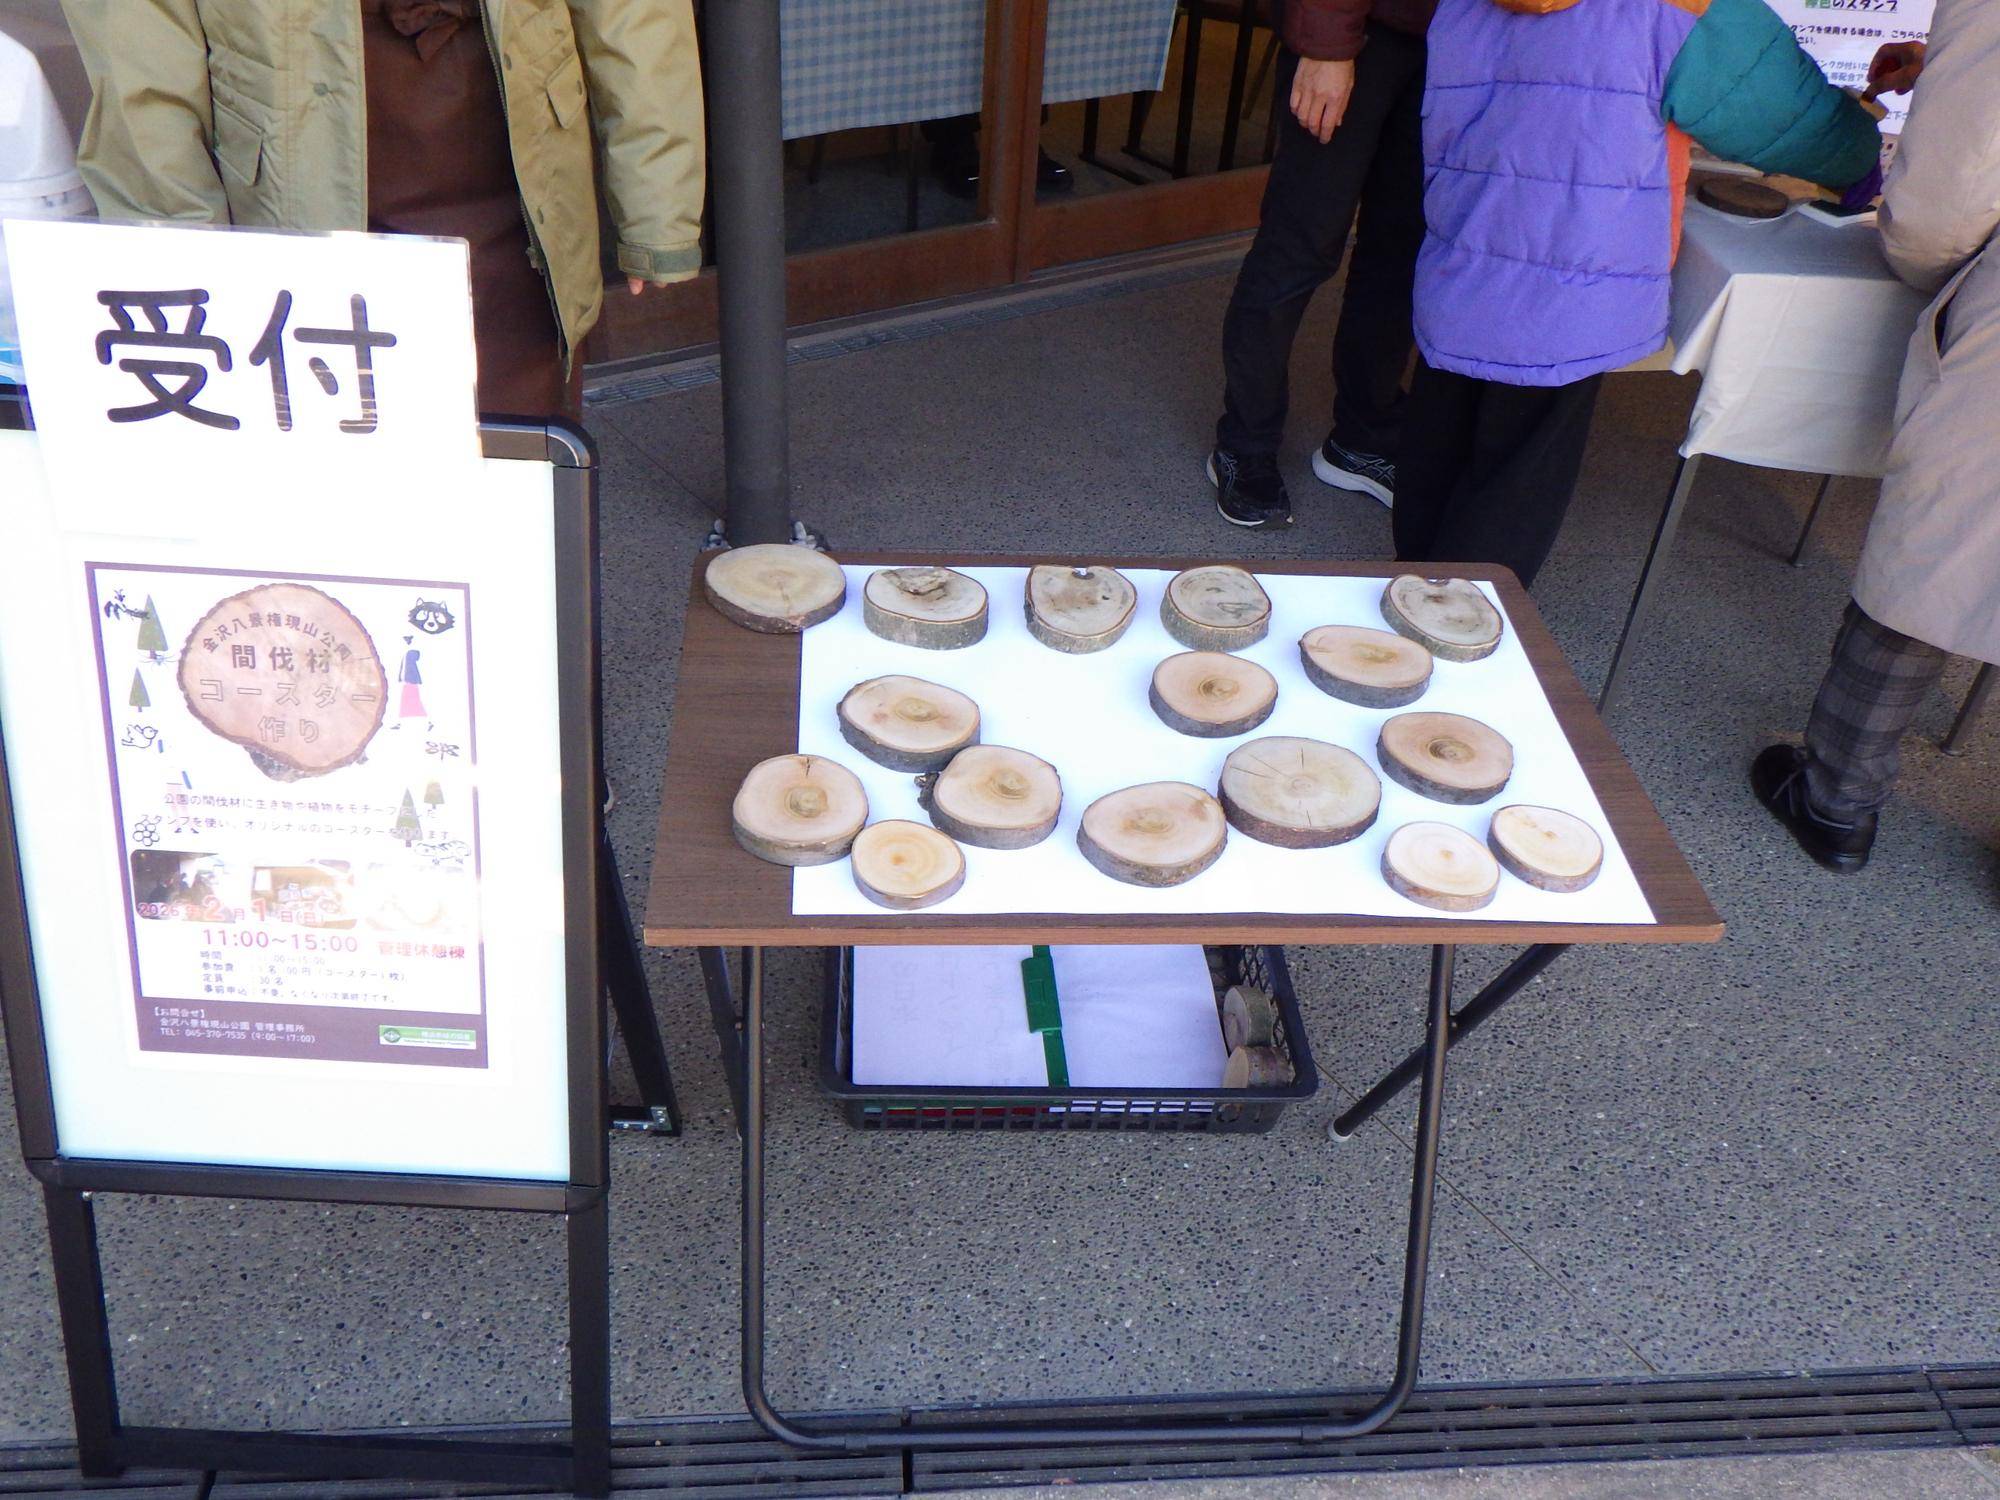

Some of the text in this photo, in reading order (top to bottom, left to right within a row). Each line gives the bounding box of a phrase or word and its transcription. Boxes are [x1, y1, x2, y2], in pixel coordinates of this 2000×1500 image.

[95, 289, 397, 433] 受付
[232, 645, 330, 674] 間伐材
[200, 679, 376, 708] コースター
[257, 716, 319, 743] 作り
[203, 929, 358, 952] 11:00～15:00
